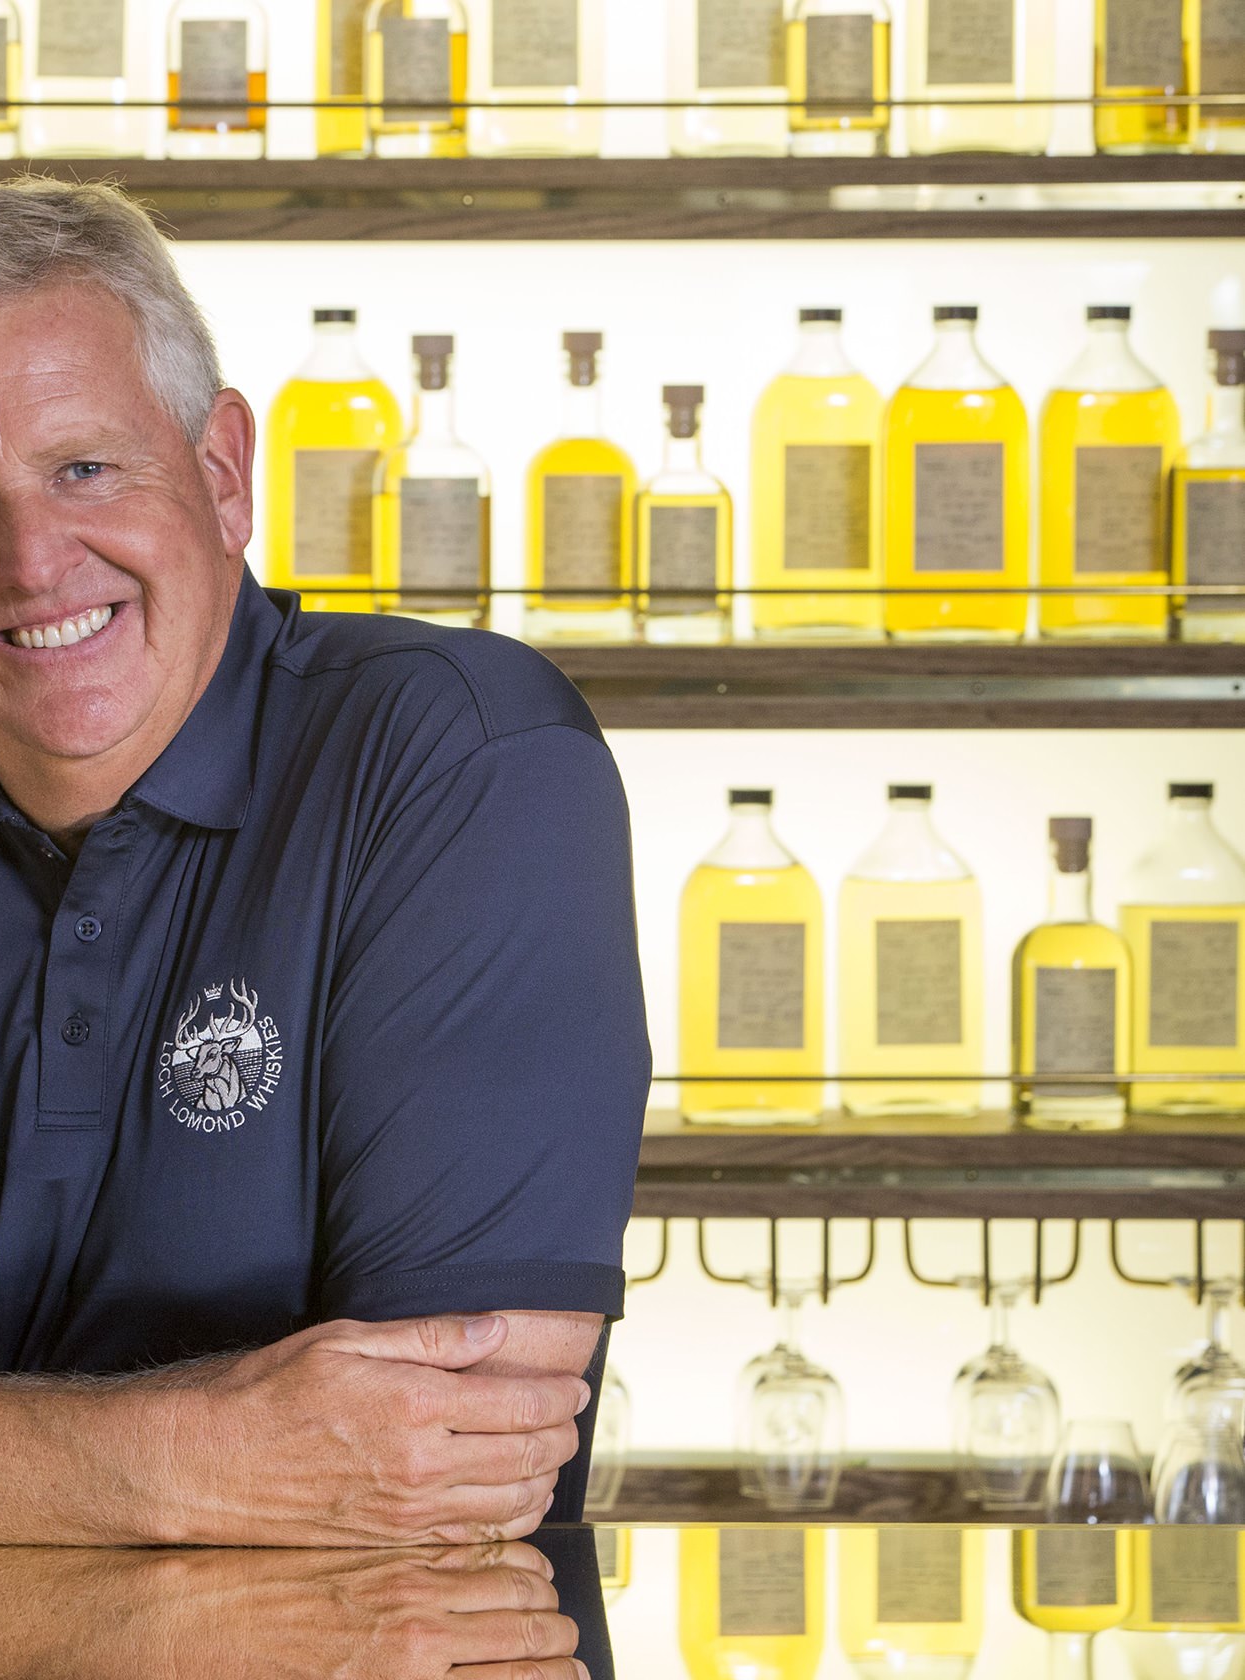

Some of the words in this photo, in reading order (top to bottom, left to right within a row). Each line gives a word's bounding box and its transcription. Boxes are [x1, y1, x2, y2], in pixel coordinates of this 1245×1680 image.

[158, 1041, 174, 1098] LOCH
[169, 1098, 245, 1133] LOMOND
[246, 1015, 283, 1112] WHISKIES
